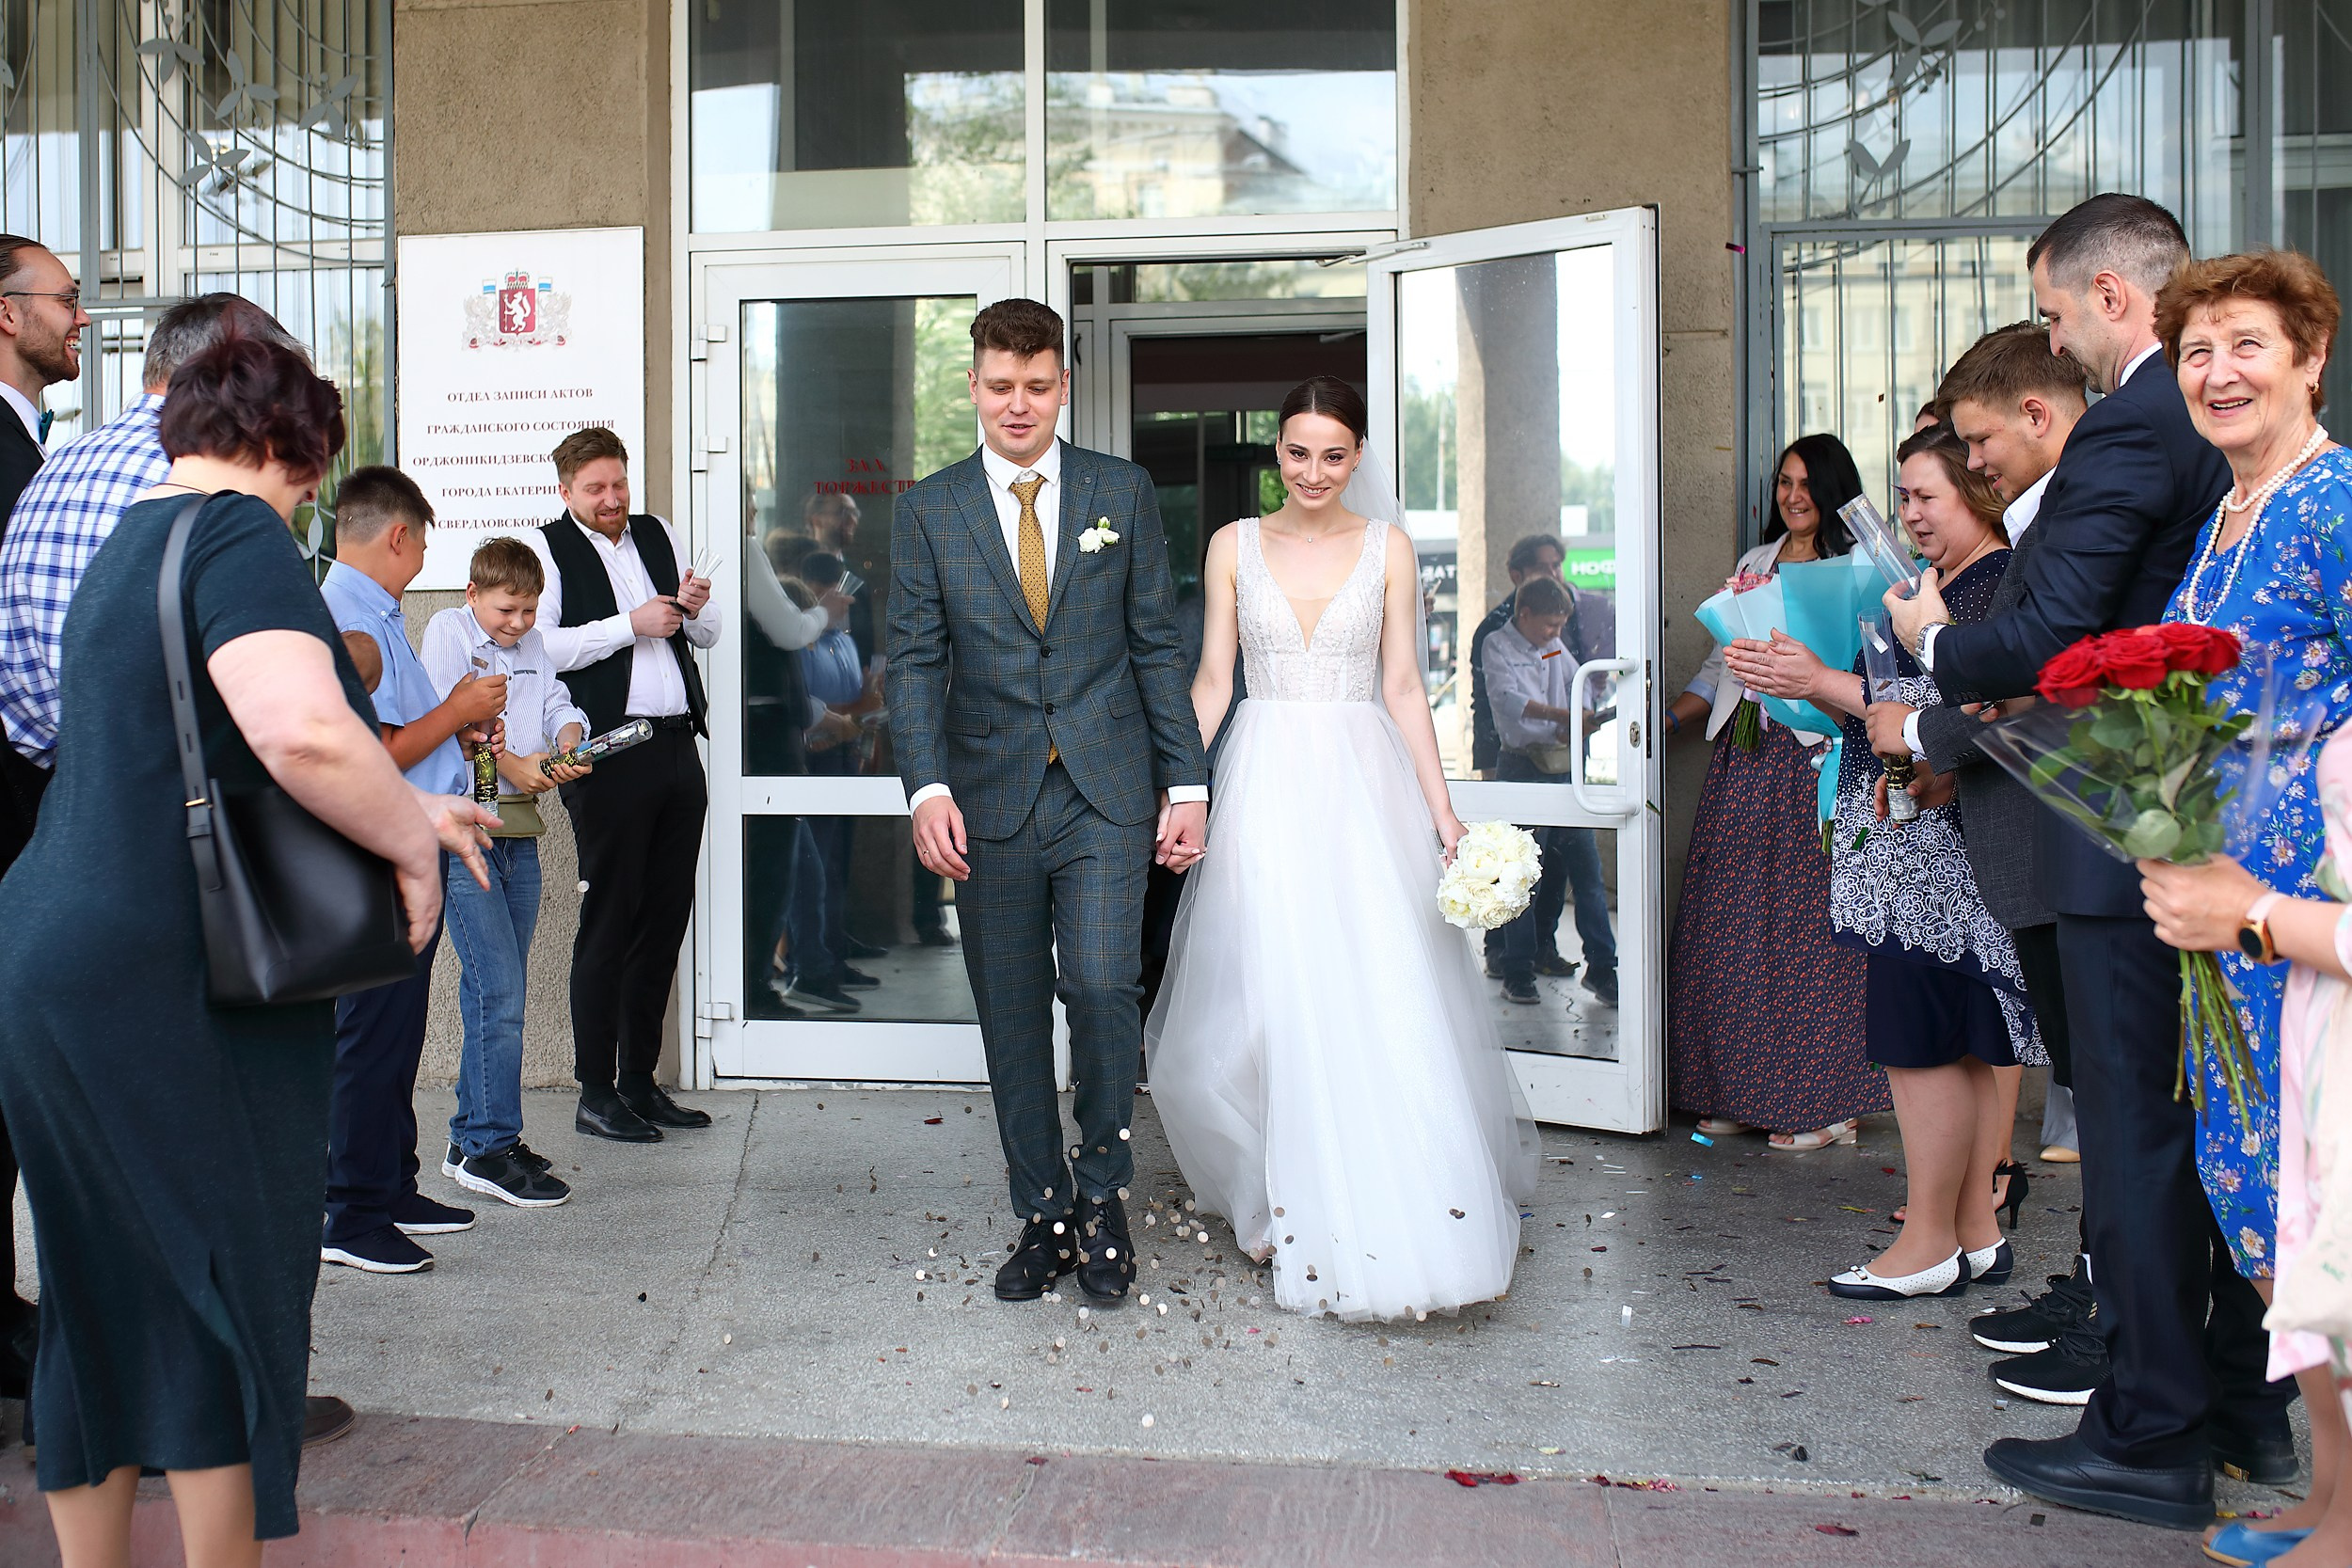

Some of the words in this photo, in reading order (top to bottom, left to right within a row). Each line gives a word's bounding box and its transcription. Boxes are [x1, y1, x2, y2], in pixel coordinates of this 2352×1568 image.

[447, 391, 490, 404] ОТДЕЛ
[493, 389, 547, 401] ЗАПИСИ
[550, 388, 594, 399] АКТОВ
[426, 422, 531, 436] ГРАЖДАНСКОГО
[532, 420, 614, 432] СОСТОЯНИЯ
[845, 458, 886, 472] ЗАЛ
[441, 487, 492, 499] ГОРОДА
[437, 515, 541, 531] СВЕРДЛОВСКОЙ
